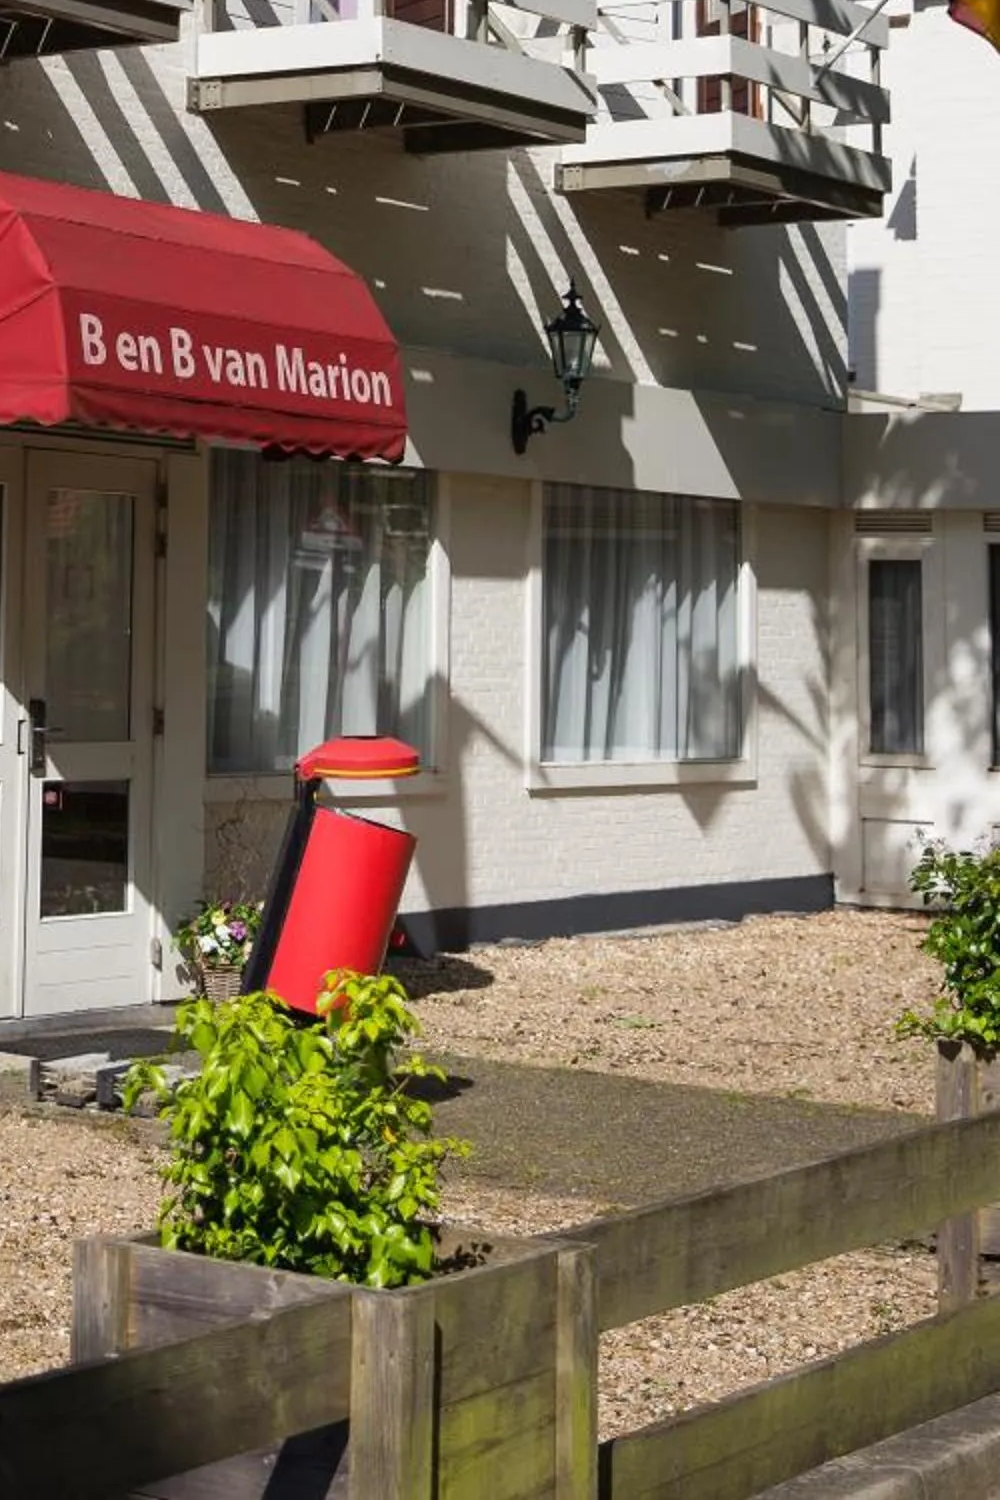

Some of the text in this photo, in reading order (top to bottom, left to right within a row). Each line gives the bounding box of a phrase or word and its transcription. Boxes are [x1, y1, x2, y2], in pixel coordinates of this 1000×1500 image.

[79, 313, 393, 407] B en B van Marion
